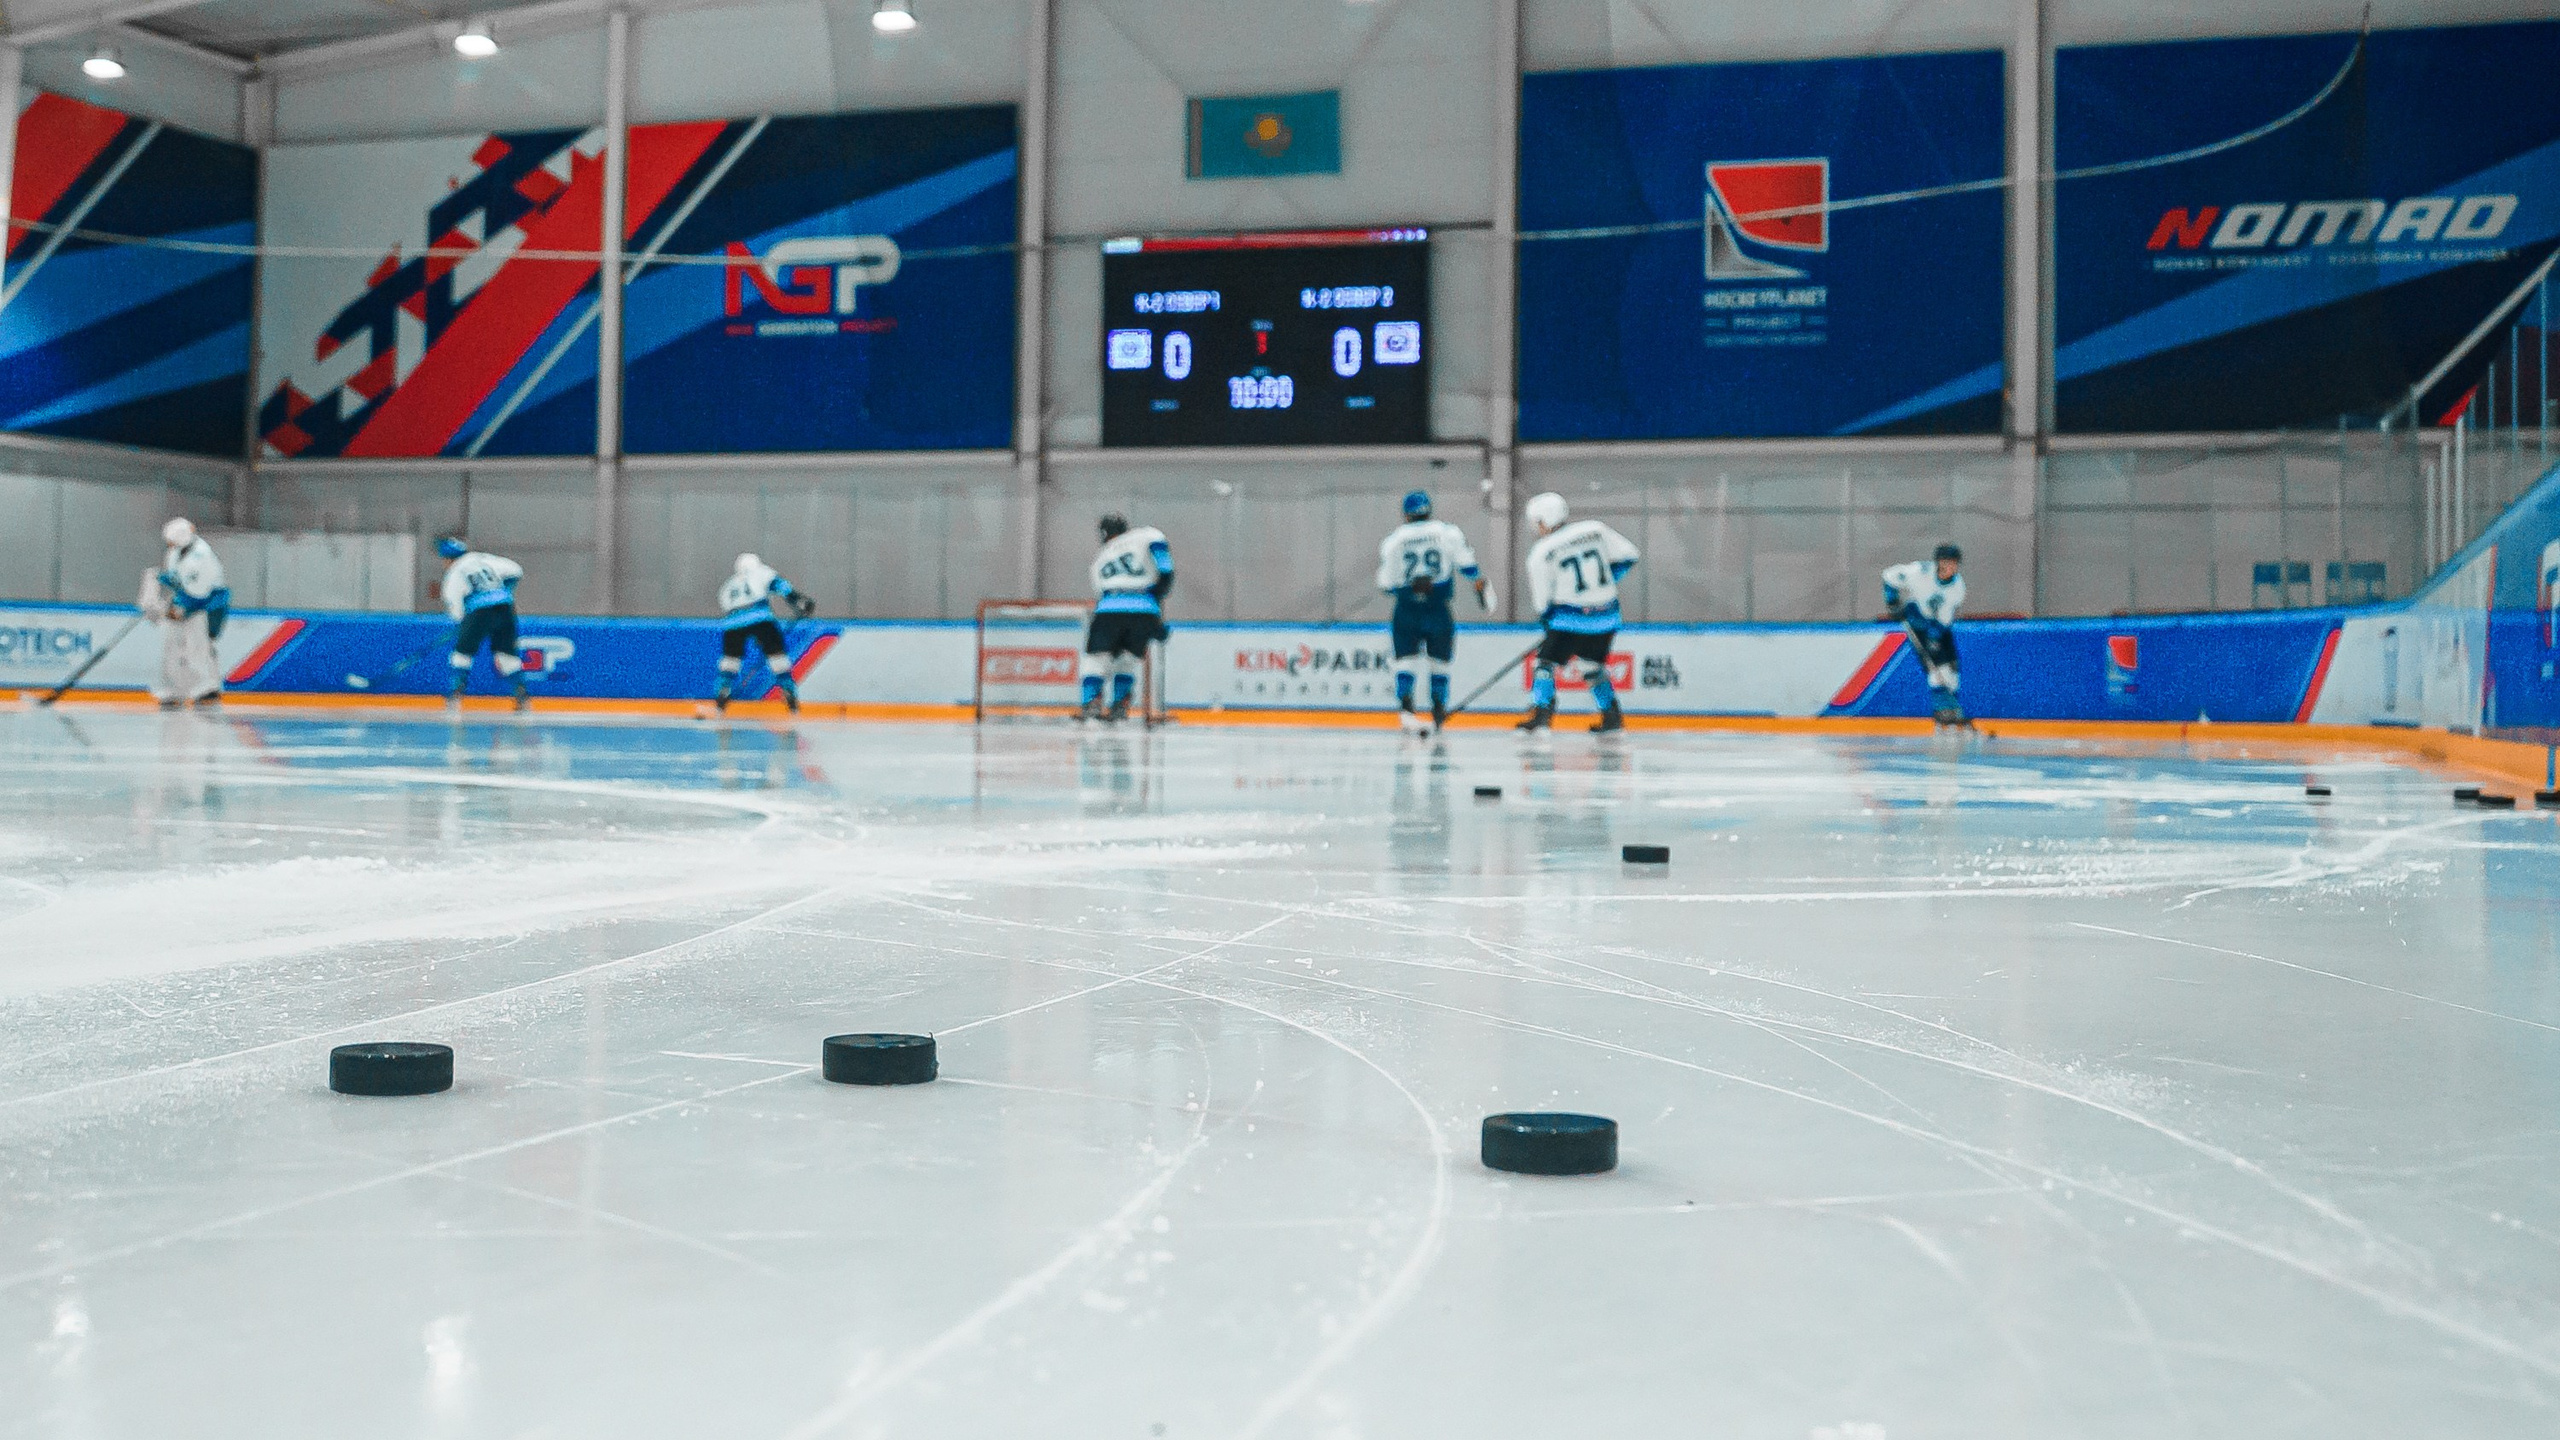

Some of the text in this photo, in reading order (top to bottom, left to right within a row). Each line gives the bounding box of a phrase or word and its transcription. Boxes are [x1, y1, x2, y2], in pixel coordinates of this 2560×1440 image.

[2146, 194, 2519, 250] NOMAD
[725, 234, 901, 317] NGP
[1163, 330, 1192, 381] 0
[1332, 326, 1362, 378] 0
[1560, 548, 1608, 593] 77
